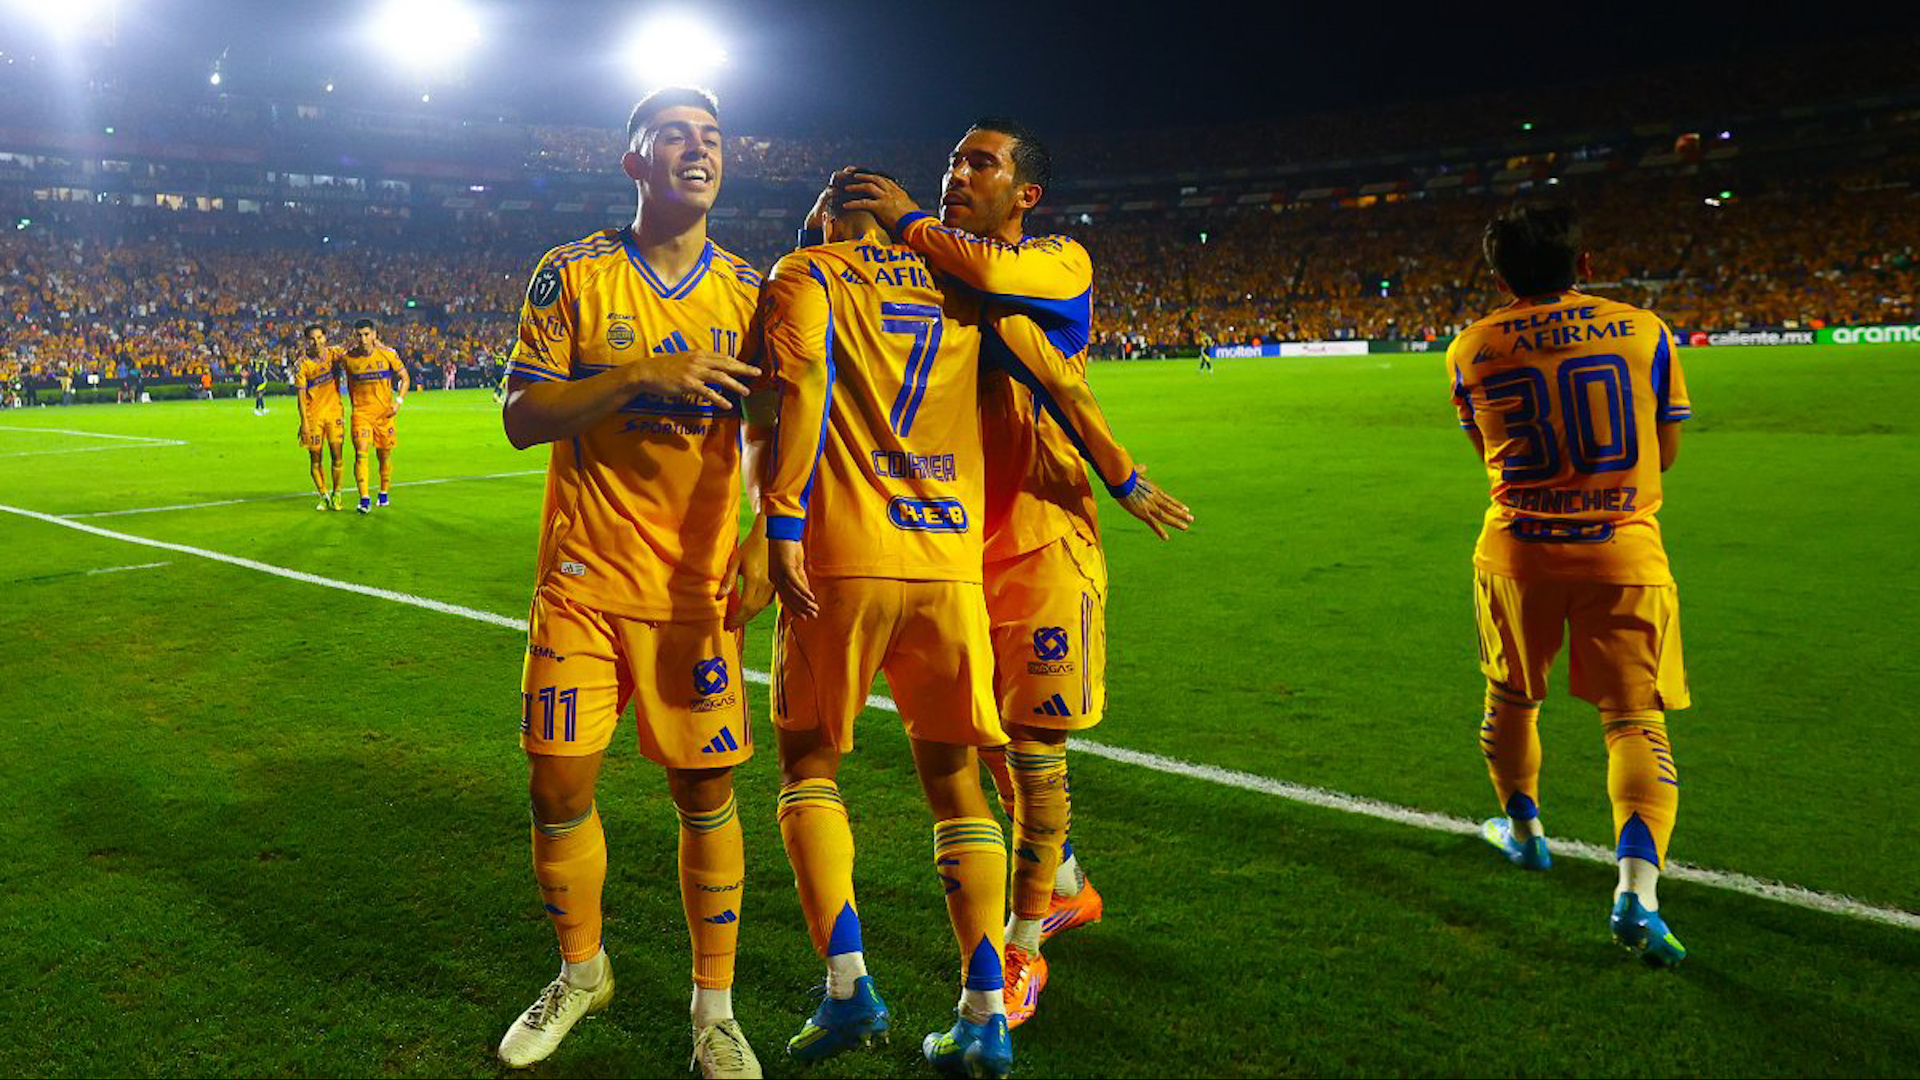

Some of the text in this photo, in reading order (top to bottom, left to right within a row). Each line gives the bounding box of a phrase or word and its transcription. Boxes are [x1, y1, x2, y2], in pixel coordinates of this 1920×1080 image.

[855, 245, 920, 263] TECA
[875, 267, 936, 291] AFIR
[1511, 319, 1635, 354] AFIRME
[1708, 330, 1814, 346] caliente.mx
[1215, 344, 1262, 358] molten
[881, 302, 943, 438] 7
[1482, 354, 1639, 482] 30
[898, 503, 965, 525] H-E-B
[539, 686, 578, 742] 11
